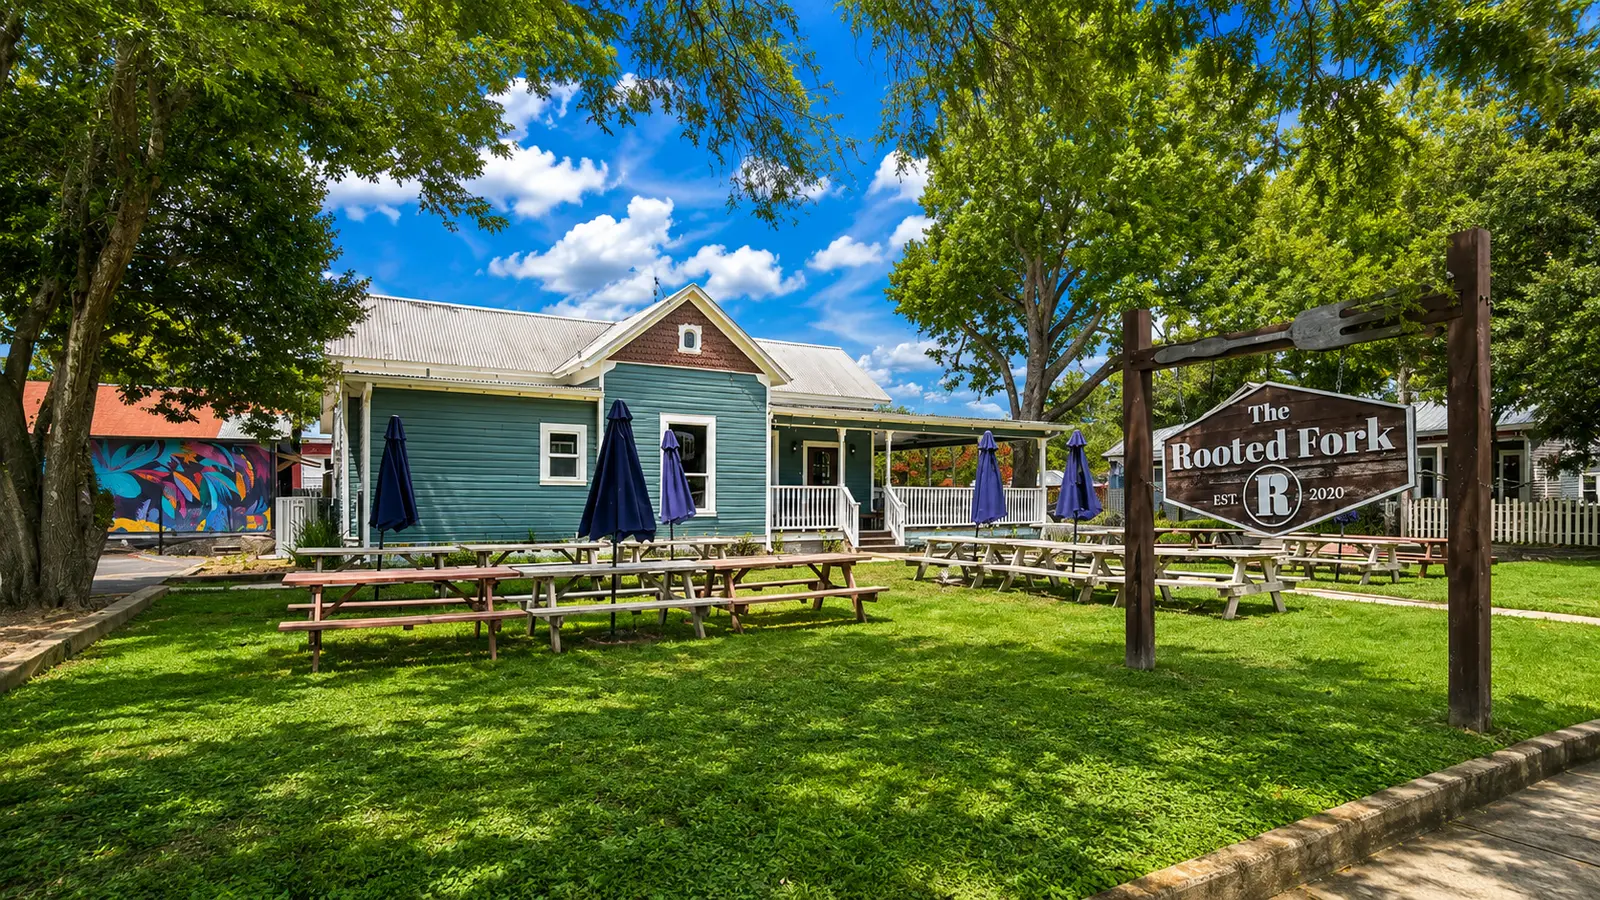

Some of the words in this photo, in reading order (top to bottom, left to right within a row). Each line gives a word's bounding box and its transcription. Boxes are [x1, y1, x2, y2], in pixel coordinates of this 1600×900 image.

[1248, 403, 1290, 424] The
[1170, 428, 1289, 471] Rooted
[1297, 416, 1396, 459] Fork
[1213, 493, 1239, 506] EST.
[1255, 473, 1292, 517] R
[1309, 486, 1345, 501] 2020
